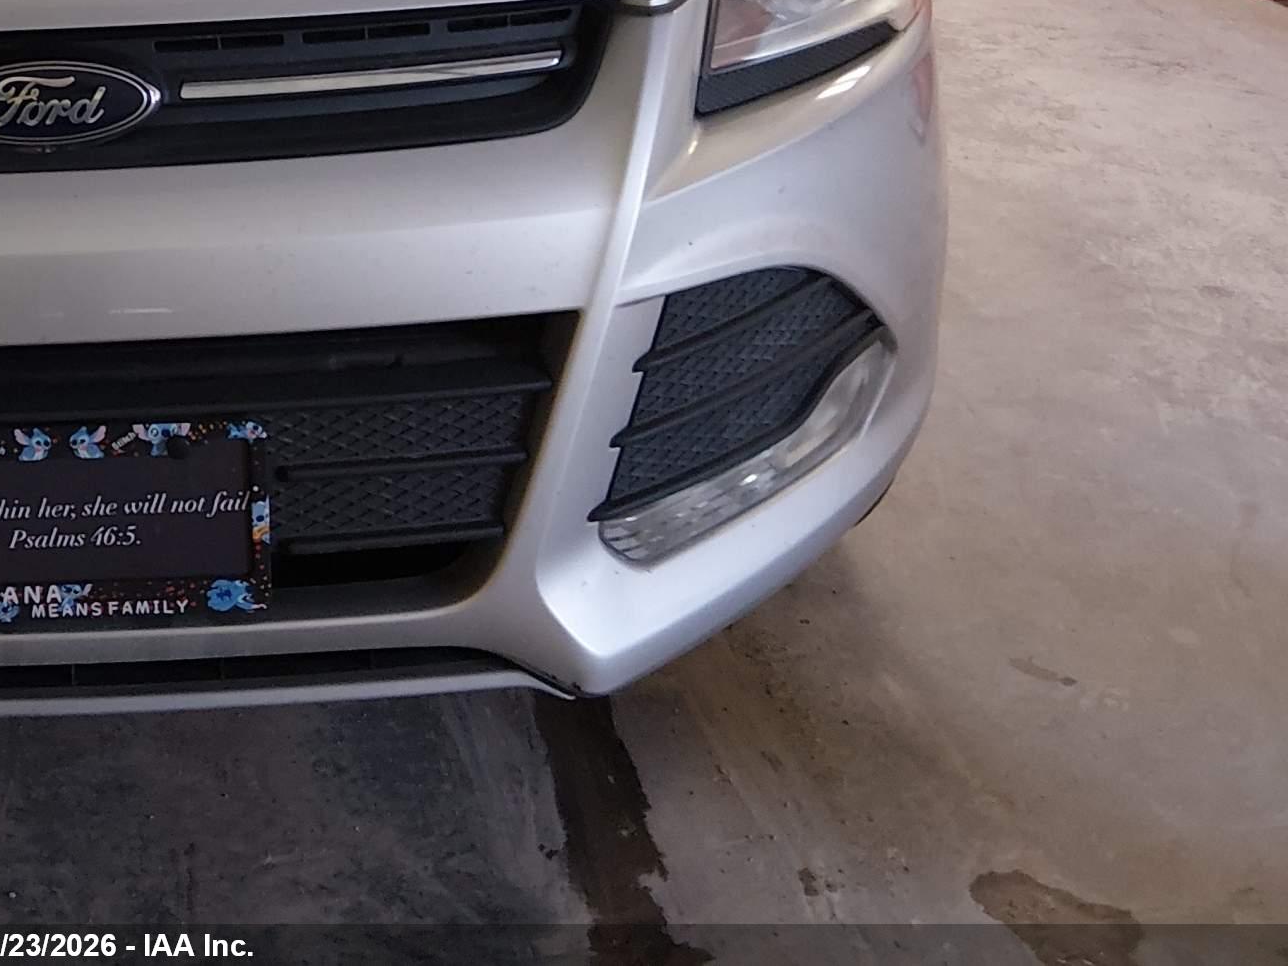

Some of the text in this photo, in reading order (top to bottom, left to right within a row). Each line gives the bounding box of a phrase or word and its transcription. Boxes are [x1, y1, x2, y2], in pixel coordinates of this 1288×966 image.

[37, 497, 76, 519] her,
[81, 495, 118, 516] she
[123, 493, 167, 514] will
[170, 497, 206, 513] not
[206, 491, 250, 518] fail
[9, 525, 142, 549] Psalms 46:5.
[31, 599, 189, 619] MEANS FAMILY
